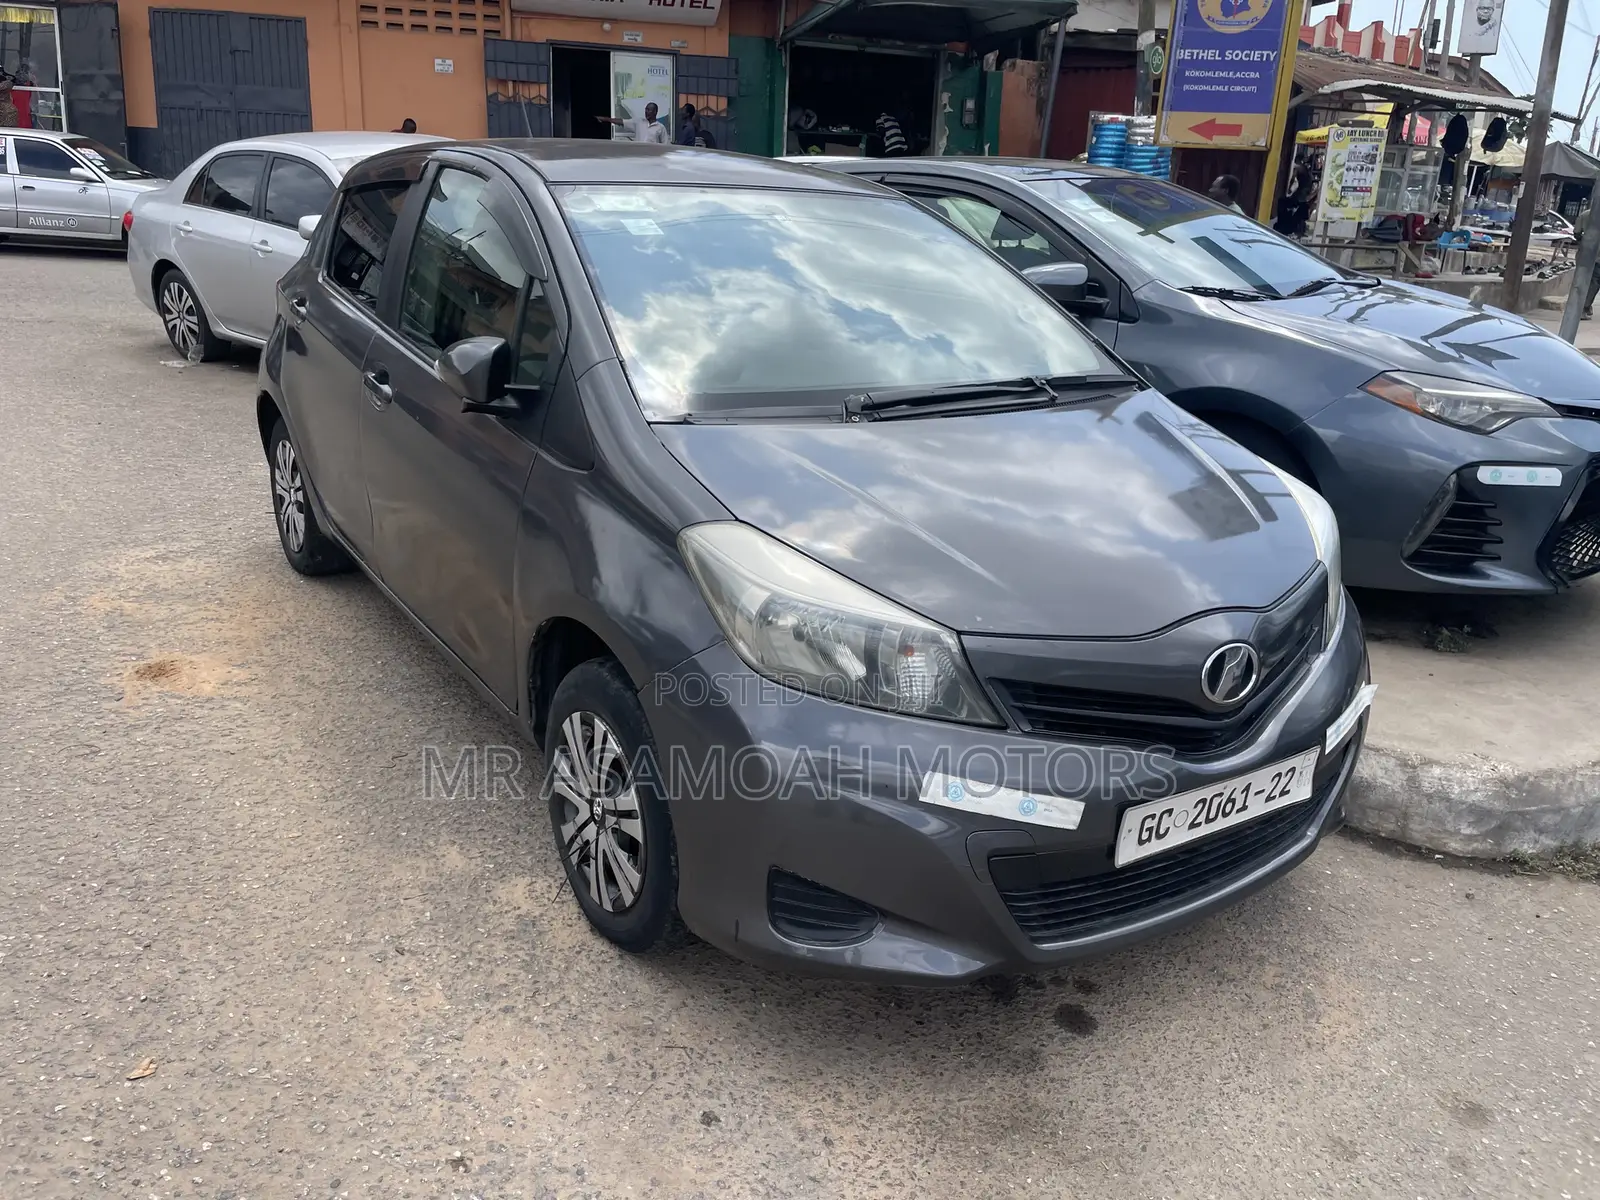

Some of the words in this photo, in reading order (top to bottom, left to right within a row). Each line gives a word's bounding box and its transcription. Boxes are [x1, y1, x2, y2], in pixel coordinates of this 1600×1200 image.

[1176, 49, 1222, 60] BETHEL
[1225, 50, 1278, 61] SOCIETY
[647, 67, 669, 76] HOTEL
[1358, 129, 1377, 137] LUNCH
[28, 216, 65, 227] Allianz
[1137, 807, 1174, 847] GC
[1187, 766, 1296, 831] 2061-22
